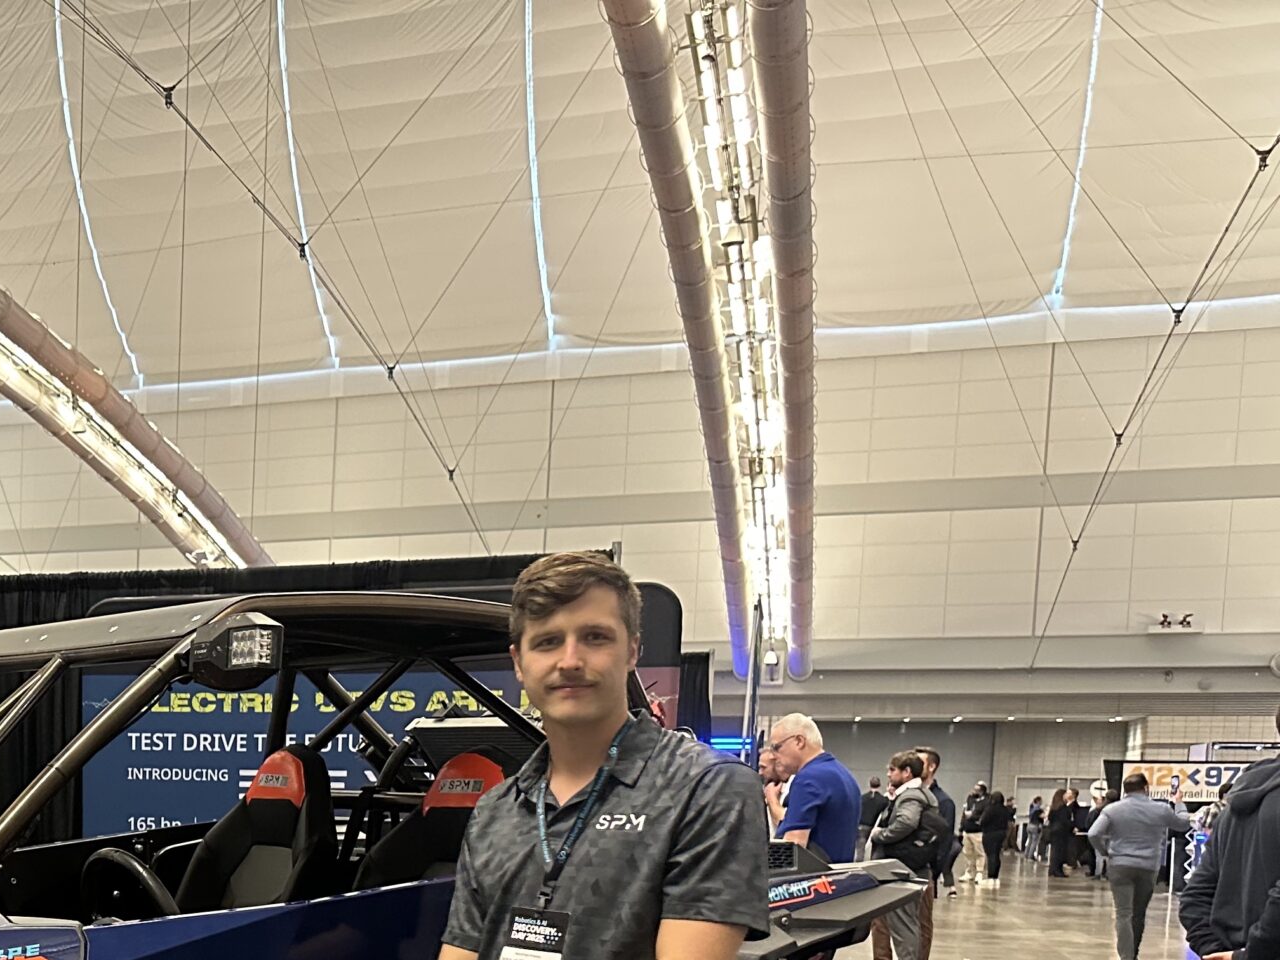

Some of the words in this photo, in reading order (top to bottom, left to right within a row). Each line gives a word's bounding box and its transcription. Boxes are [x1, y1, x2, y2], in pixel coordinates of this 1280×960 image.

[128, 733, 177, 752] TEST
[183, 733, 247, 752] DRIVE
[254, 734, 296, 752] TE
[127, 767, 229, 782] INTRODUCING
[448, 779, 470, 791] SPM
[128, 817, 155, 831] 165
[595, 814, 646, 831] SPM
